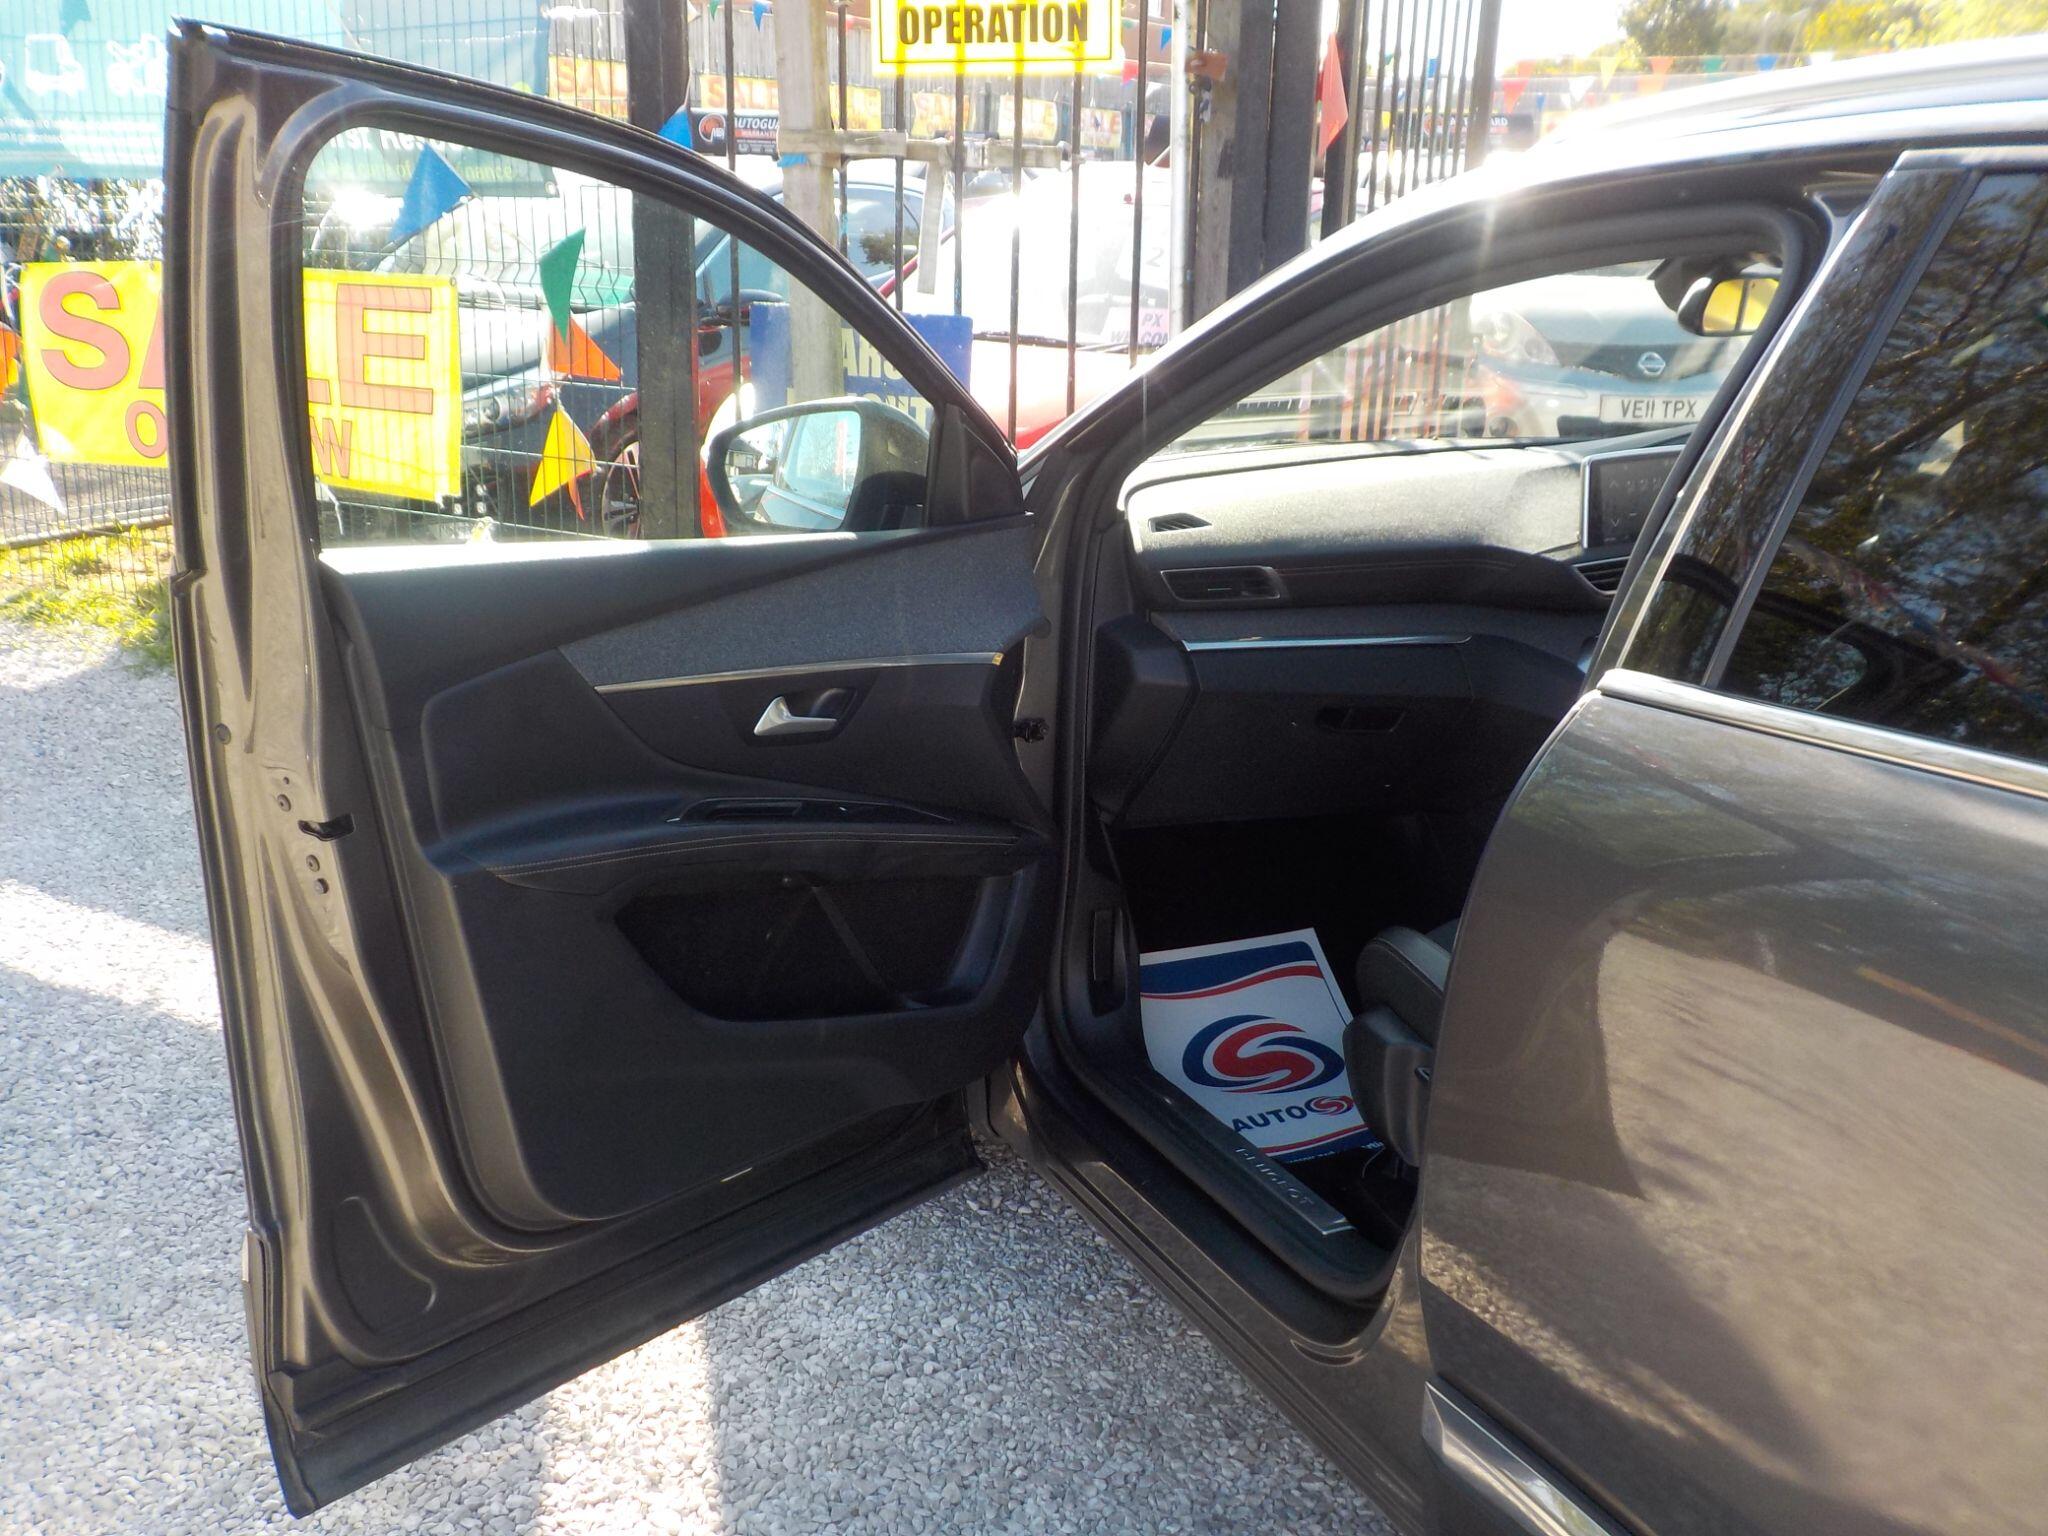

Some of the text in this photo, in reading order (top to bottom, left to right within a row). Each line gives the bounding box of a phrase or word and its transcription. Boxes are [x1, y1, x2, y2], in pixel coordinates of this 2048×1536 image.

[899, 3, 1088, 45] OPERATION
[1141, 312, 1163, 327] PX
[1662, 400, 1697, 418] TPX
